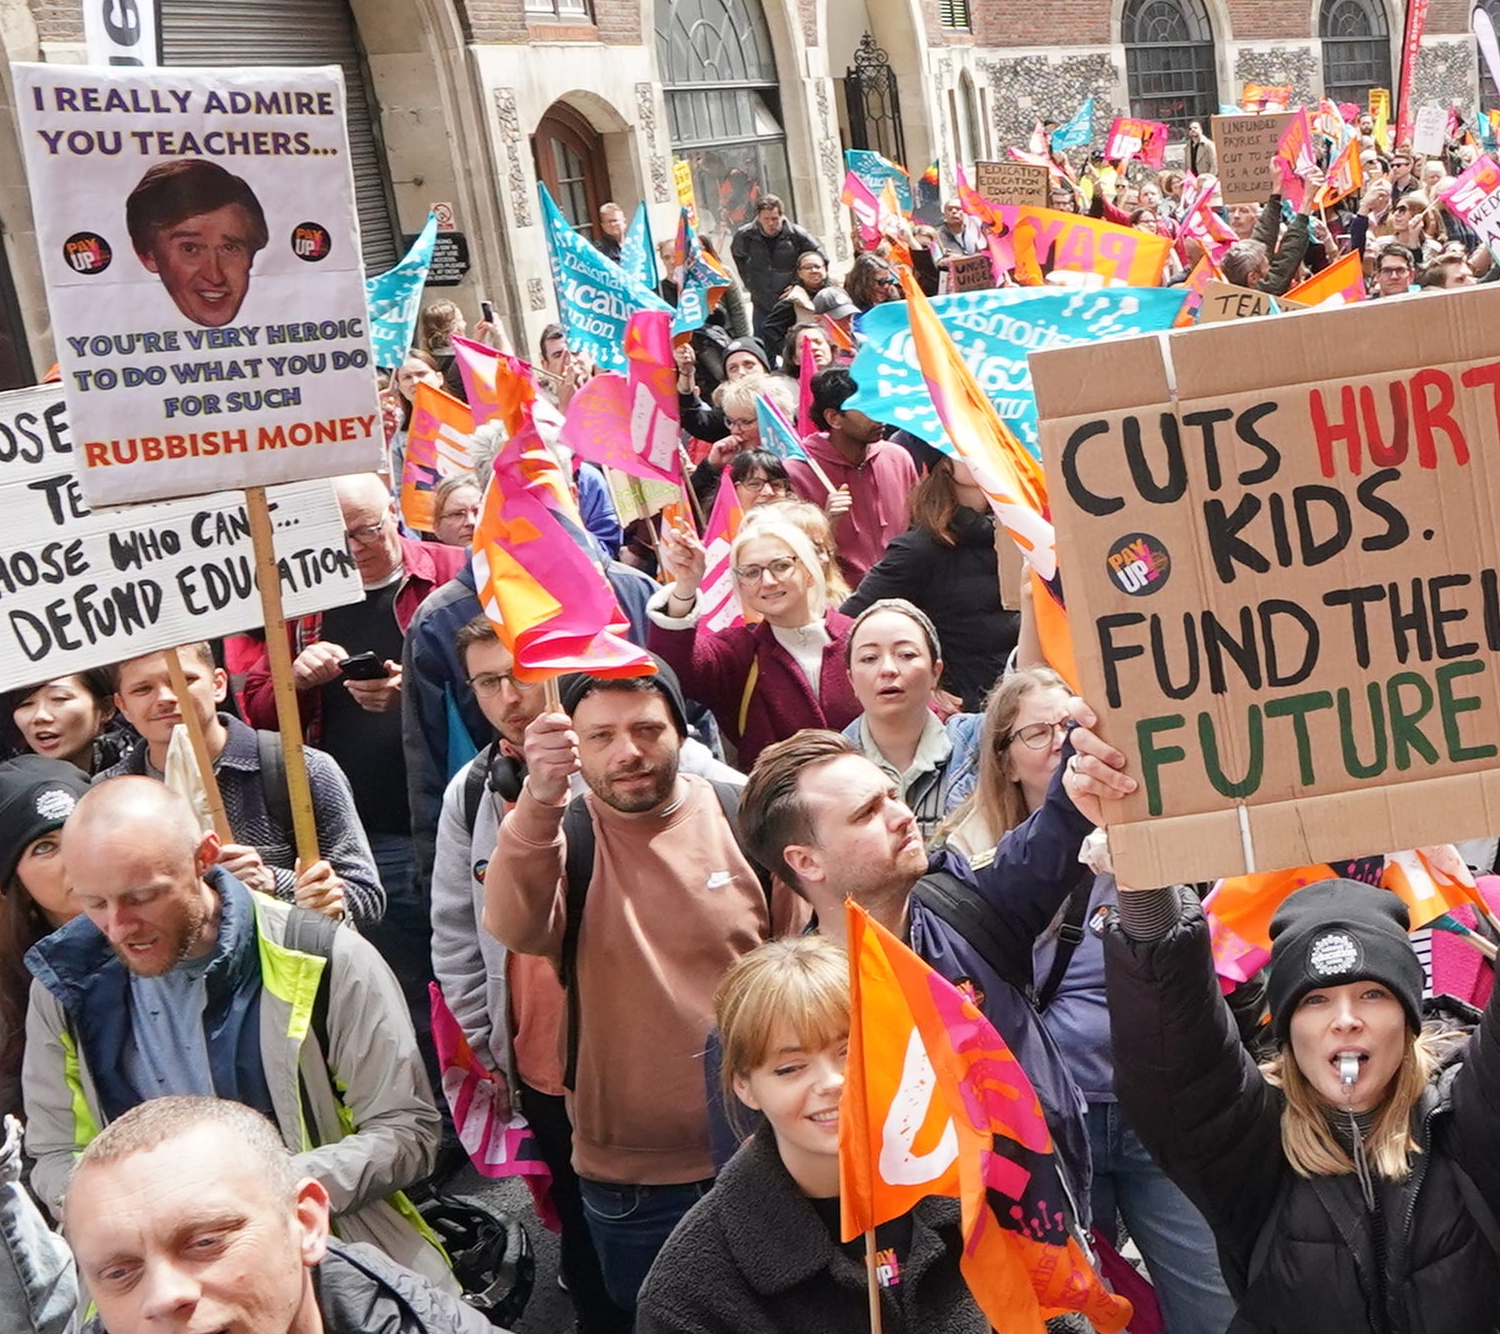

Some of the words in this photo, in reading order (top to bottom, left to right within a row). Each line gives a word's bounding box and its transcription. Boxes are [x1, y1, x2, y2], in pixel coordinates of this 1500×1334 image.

[32, 86, 45, 112] I
[54, 86, 193, 114] REALLY
[203, 90, 335, 116] ADMIRE
[1118, 120, 1156, 140] PAY
[1221, 119, 1277, 135] UNFUNDED
[1223, 135, 1261, 148] PAYRISE
[37, 130, 123, 156] YOU
[131, 130, 339, 157] TEACHERS...
[1222, 153, 1242, 164] CUT
[1249, 151, 1260, 161] TO
[980, 176, 1040, 186] EDUCATION
[984, 165, 1046, 179] EDUCATION
[1226, 169, 1236, 178] IS
[1242, 168, 1249, 178] A
[1469, 201, 1491, 226] WE
[65, 237, 99, 255] PAY
[67, 330, 179, 358] YOU'RE
[186, 325, 261, 352] VERY
[267, 318, 364, 345] HEROIC
[74, 369, 118, 392] TO
[125, 365, 167, 388] DO
[171, 358, 263, 384] WHAT
[269, 353, 326, 379] YOU
[331, 349, 369, 372] DO
[164, 394, 222, 418] FOR
[228, 387, 302, 413] SUCH
[84, 429, 249, 468] RUBBISH
[258, 415, 378, 451] MONEY
[1060, 400, 1281, 518] CUTS
[1203, 468, 1436, 584] KIDS.
[110, 527, 181, 572] WHO
[1107, 539, 1149, 573] PAY
[9, 578, 162, 663] DEFUND
[176, 548, 358, 617] EDUATION
[1094, 598, 1319, 709] FUND
